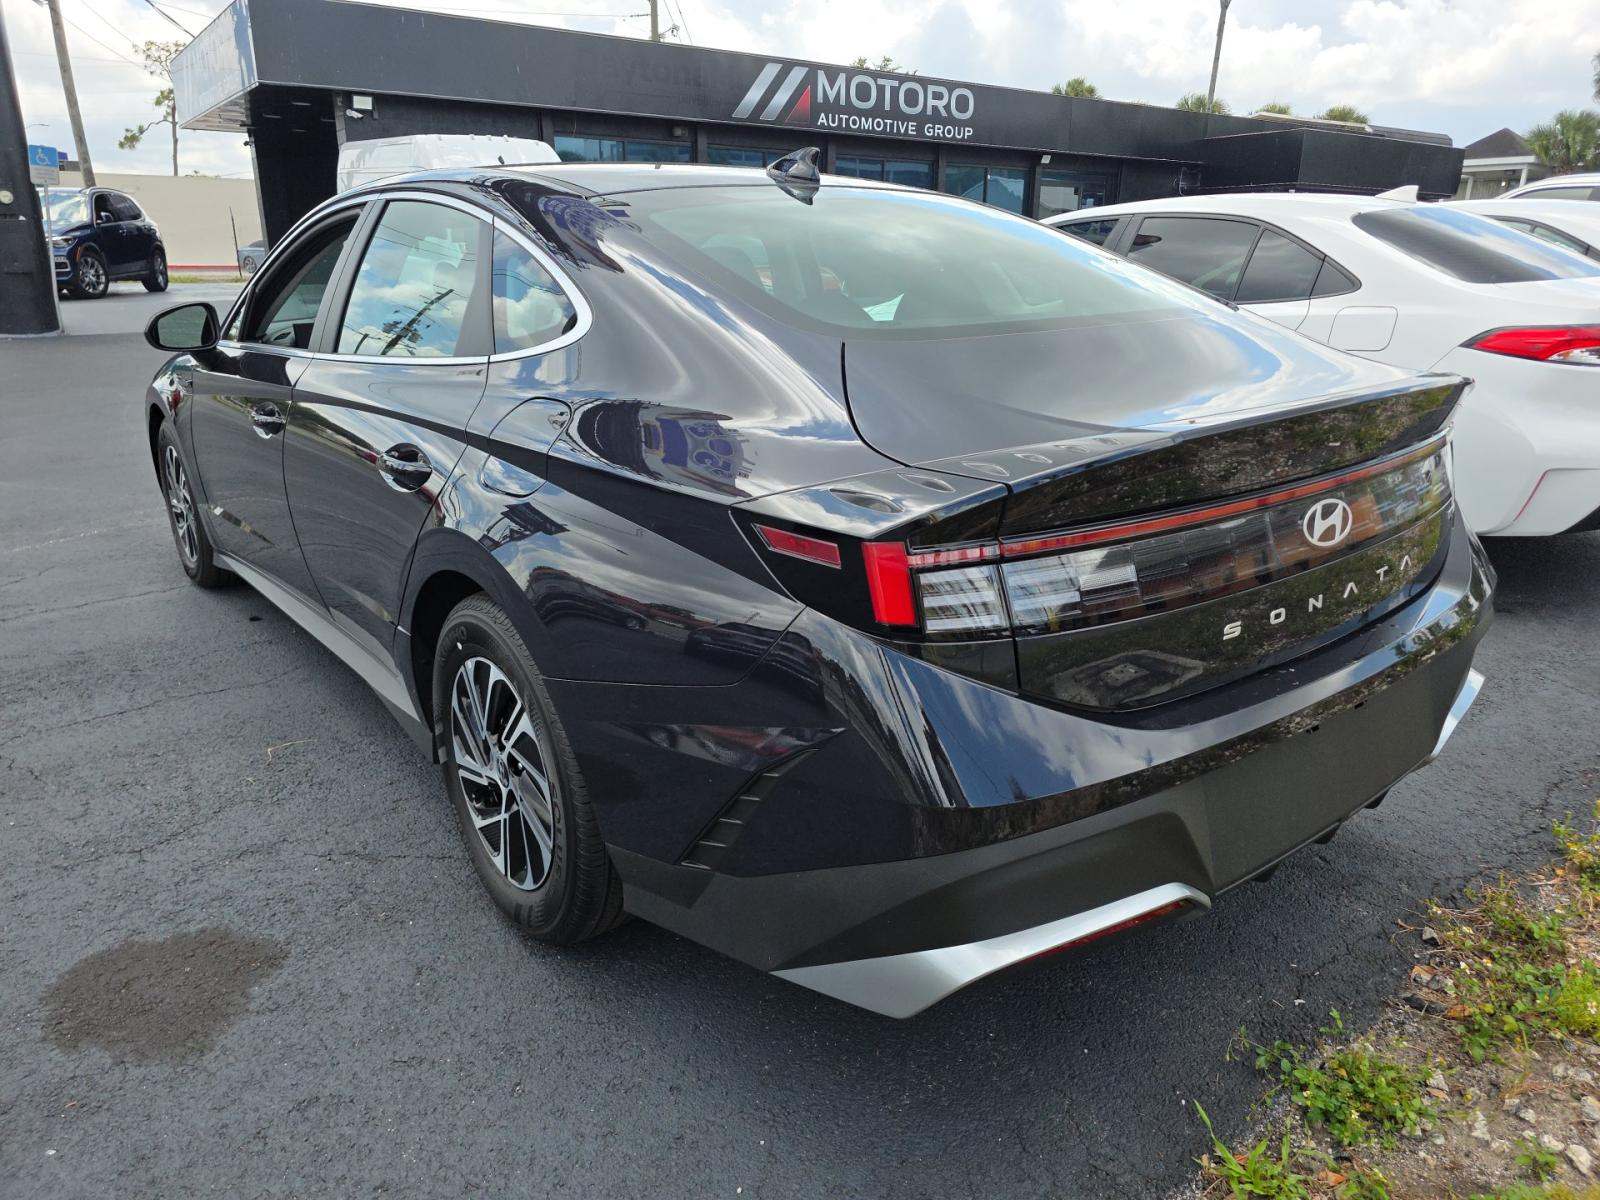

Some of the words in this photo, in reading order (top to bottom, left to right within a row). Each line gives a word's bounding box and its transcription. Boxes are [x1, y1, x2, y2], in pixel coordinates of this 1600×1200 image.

[816, 69, 975, 120] MOTORO
[817, 112, 917, 135] AUTOMOTIVE
[924, 123, 974, 139] GROUP
[1222, 554, 1412, 641] SONATA
